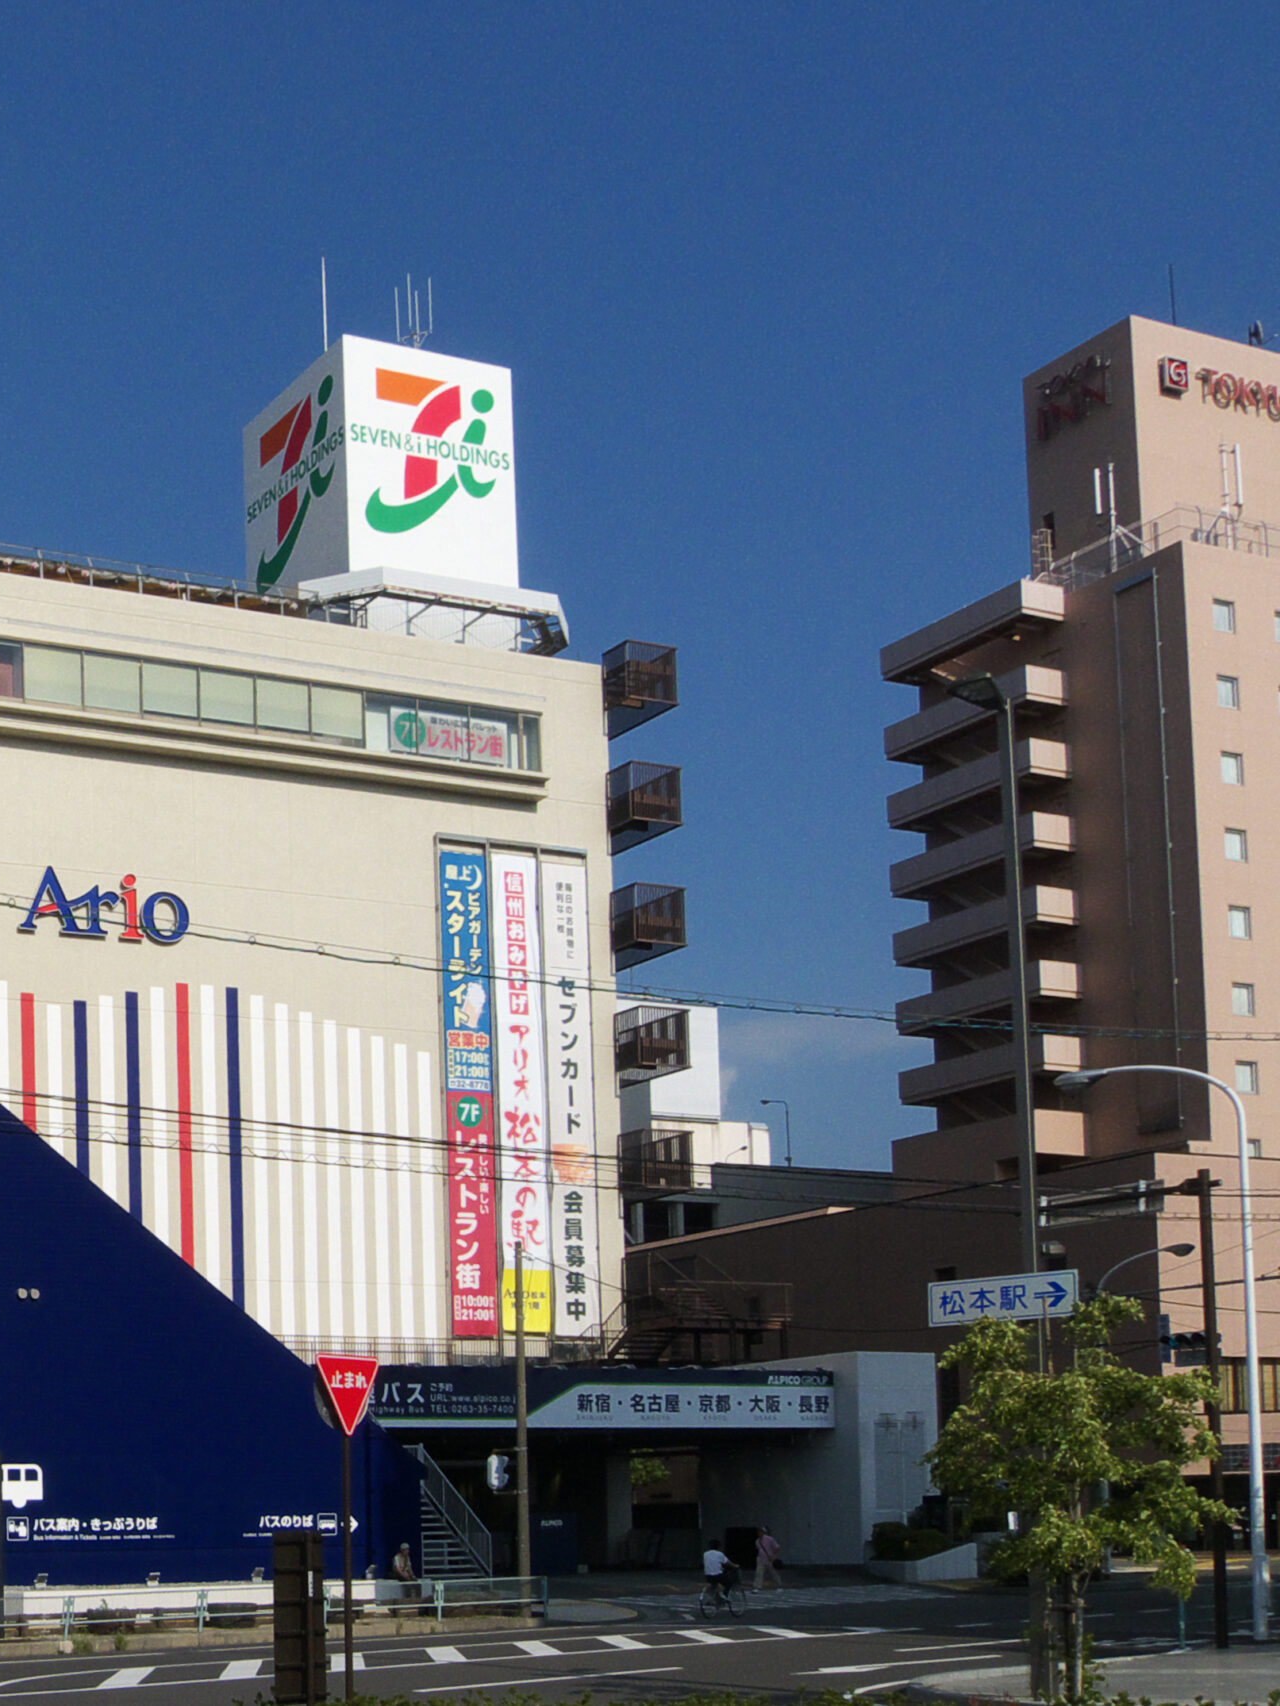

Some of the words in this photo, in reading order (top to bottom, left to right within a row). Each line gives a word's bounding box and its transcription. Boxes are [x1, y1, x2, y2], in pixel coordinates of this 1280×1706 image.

[289, 426, 344, 487] HOLDINGS
[426, 436, 510, 470] HOLDINGS
[427, 726, 503, 758] レストラン街
[18, 865, 190, 943] Ario
[468, 892, 482, 975] ビアガーデン
[557, 975, 581, 1134] セブンカード
[459, 1103, 479, 1121] 7F
[455, 1130, 480, 1290] レストラン街
[564, 1190, 587, 1322] 会員募集中
[939, 1284, 1029, 1317] 松本駅
[331, 1371, 368, 1389] 止まれ
[259, 1514, 314, 1528] バスのりば
